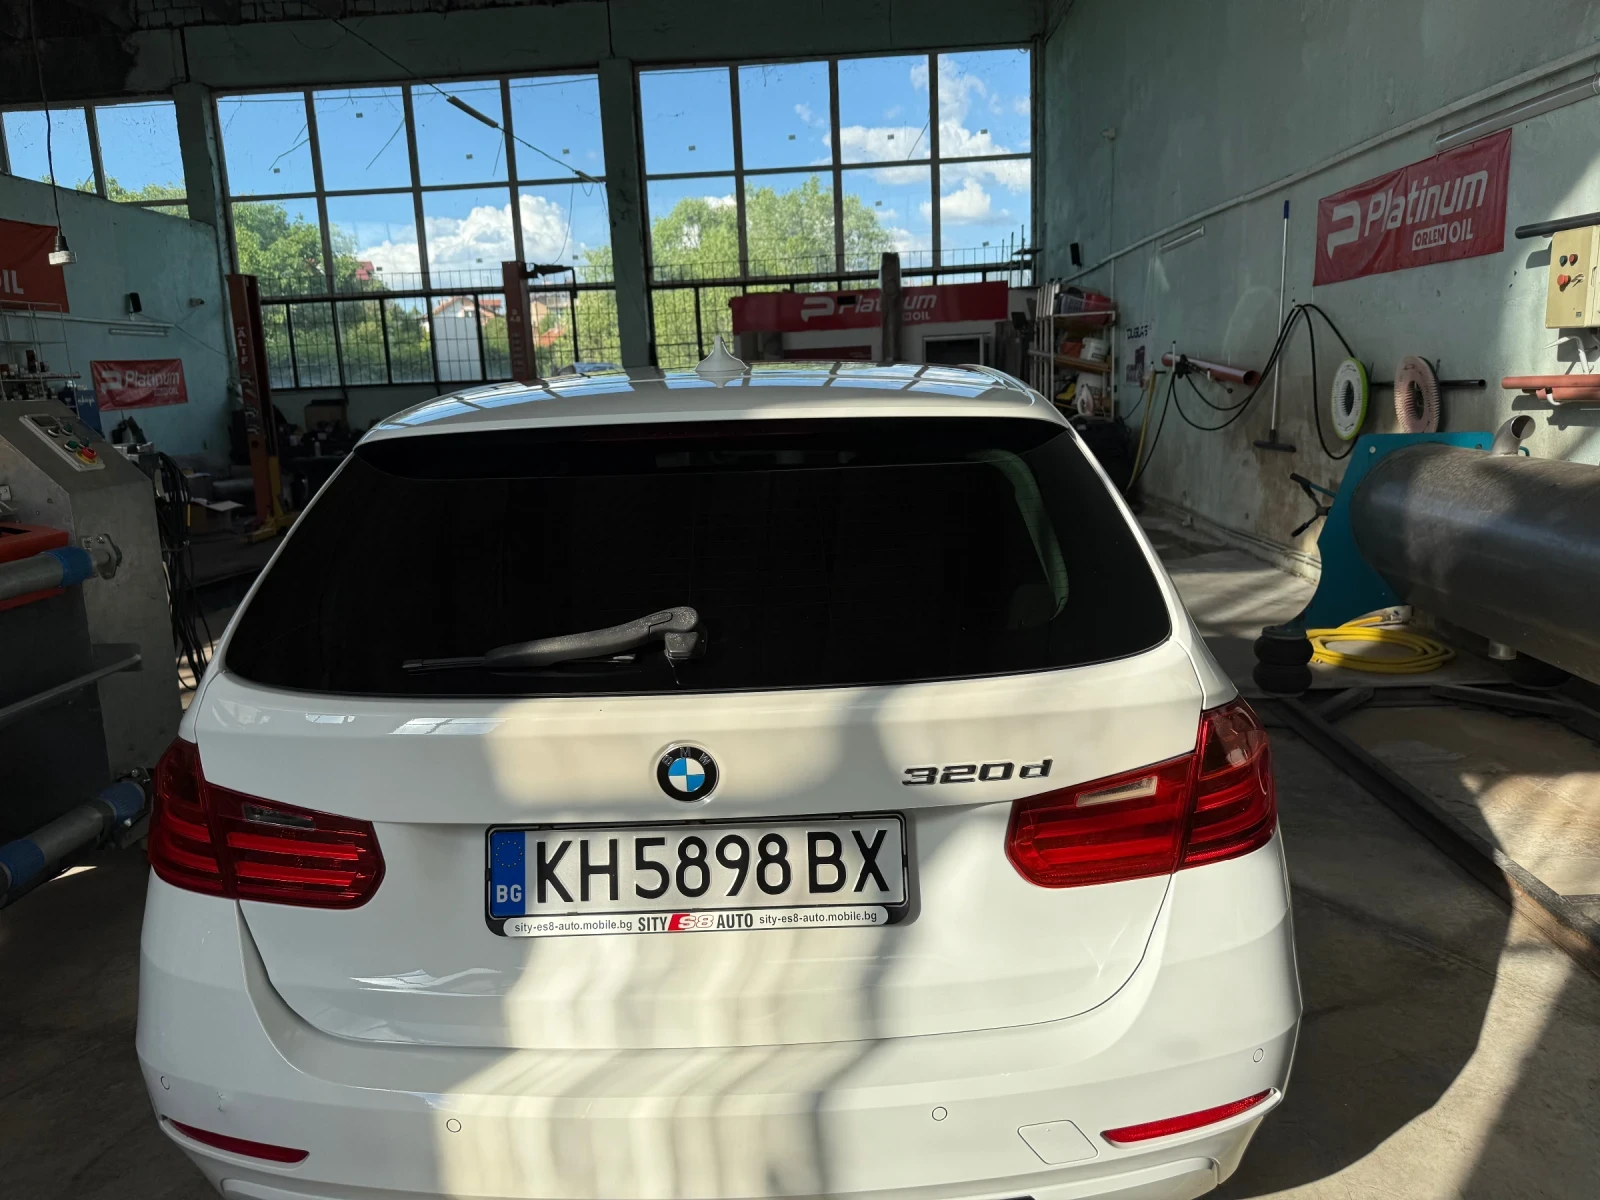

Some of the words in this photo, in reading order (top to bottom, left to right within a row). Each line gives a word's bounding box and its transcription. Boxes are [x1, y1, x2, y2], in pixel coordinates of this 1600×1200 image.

[1364, 170, 1489, 237] Platinum
[1414, 227, 1446, 247] ORLEN
[1448, 217, 1474, 243] OIL
[0, 268, 24, 295] IL
[124, 369, 180, 389] Platinum
[661, 747, 712, 768] BMW
[901, 757, 1053, 786] 320d
[496, 884, 522, 903] BG
[514, 920, 633, 934] sity-es8-auto.mobile.bg
[637, 916, 668, 932] SITY
[717, 912, 755, 929] AUTO
[758, 910, 878, 926] sity-es8-auto.mobile.bg
